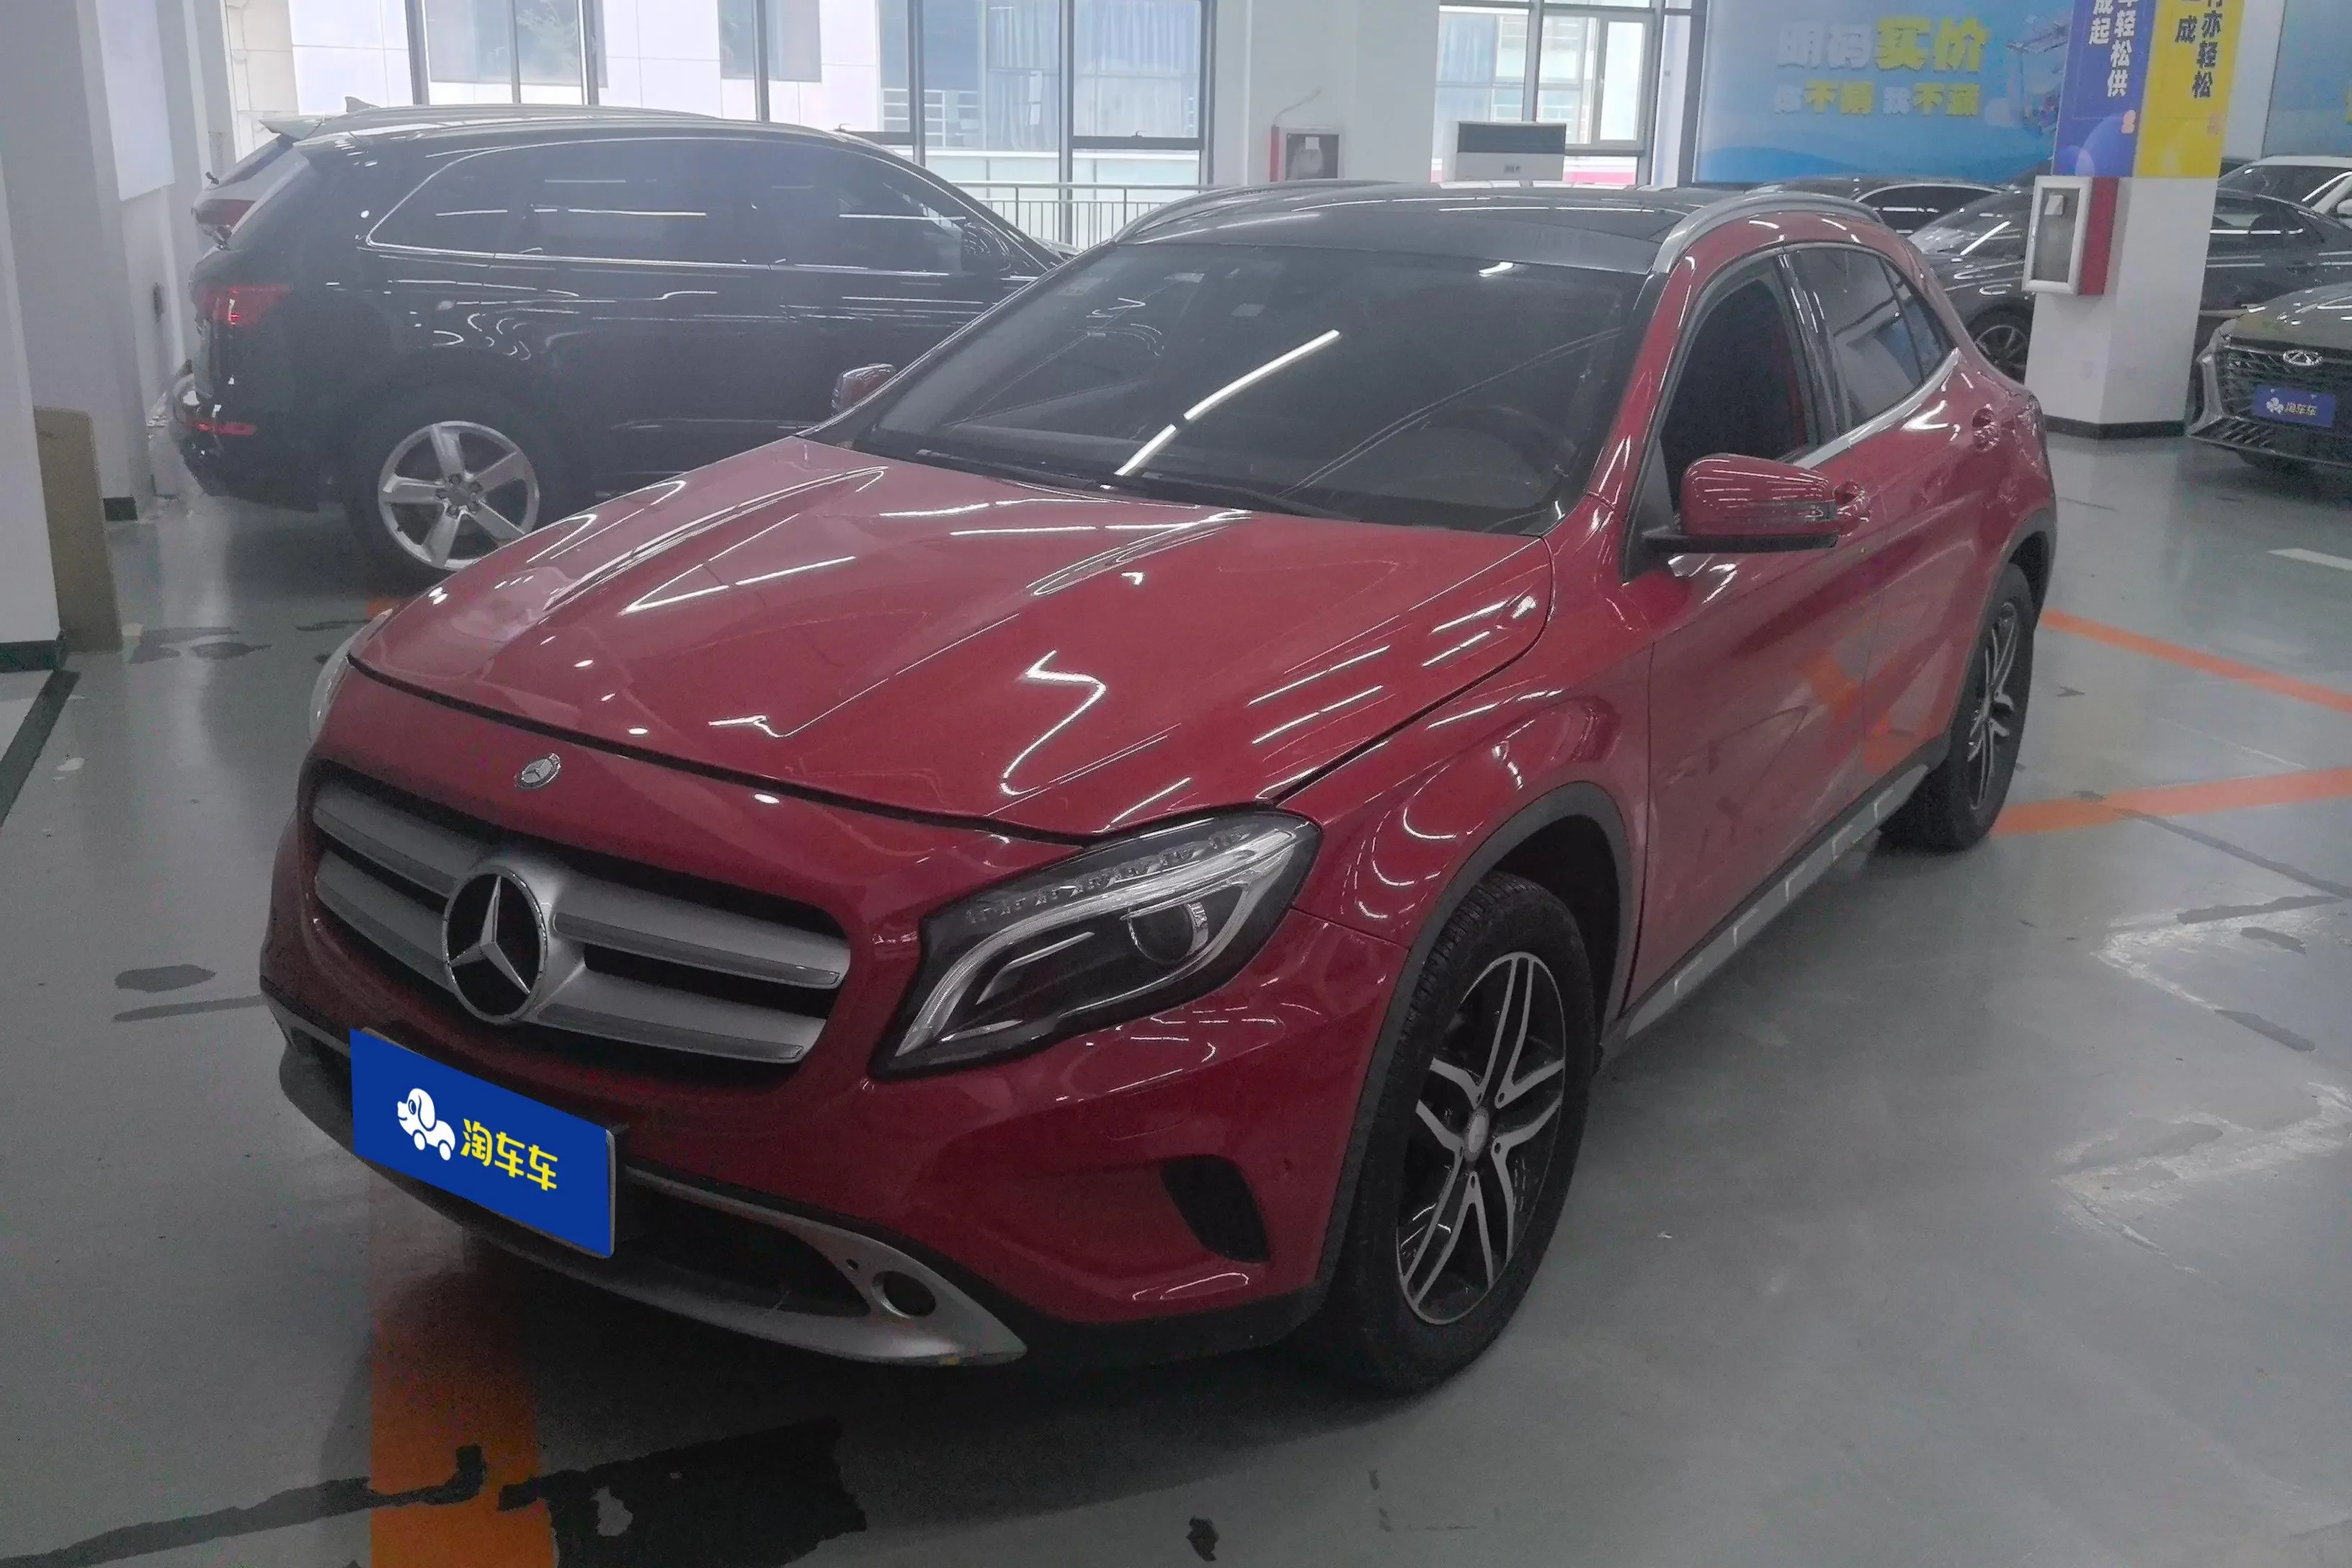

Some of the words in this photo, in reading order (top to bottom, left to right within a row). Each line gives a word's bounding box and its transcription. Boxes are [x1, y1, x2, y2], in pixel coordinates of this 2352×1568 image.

[2107, 0, 2138, 97] 轻松供
[2192, 0, 2222, 98] 亦轻松
